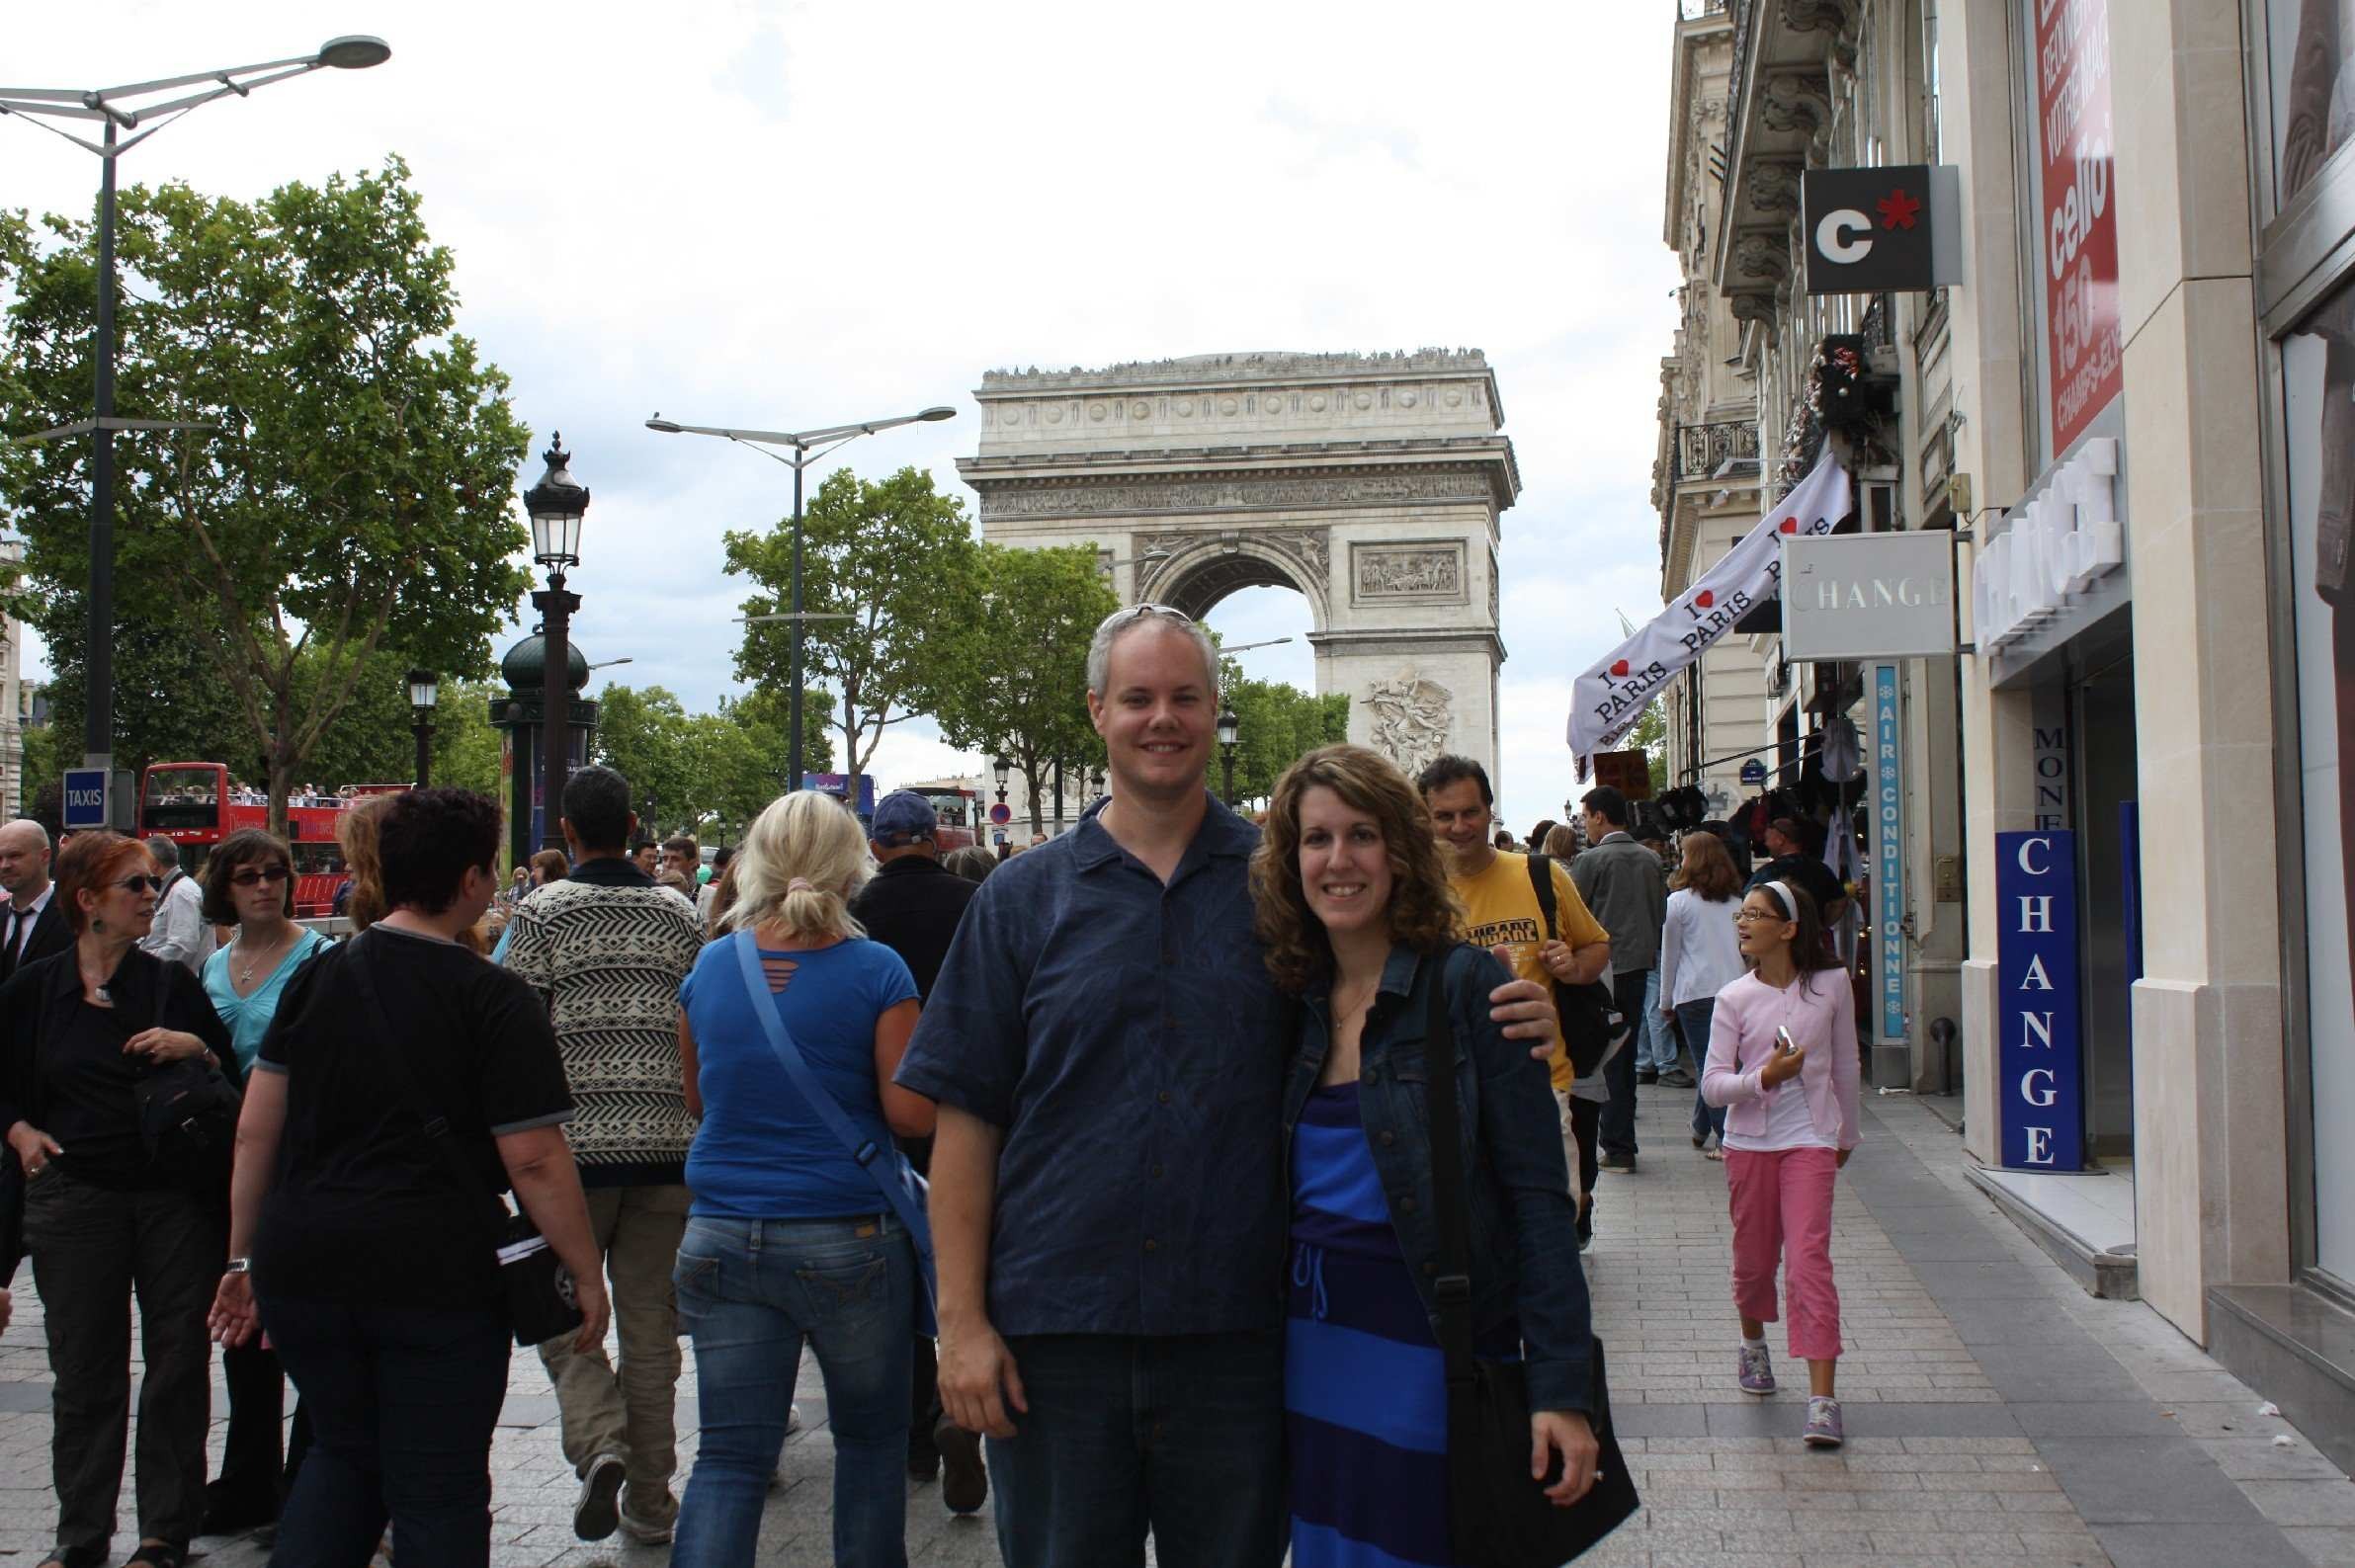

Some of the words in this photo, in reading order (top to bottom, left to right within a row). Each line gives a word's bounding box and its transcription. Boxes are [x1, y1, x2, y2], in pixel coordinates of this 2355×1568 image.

[2047, 63, 2079, 166] VOTRE
[2055, 254, 2093, 379] 150
[2057, 320, 2121, 432] CHAMPS-ÉLY
[1680, 590, 1751, 654] PARIS
[1684, 602, 1702, 620] I
[1594, 661, 1667, 724] PARIS
[1598, 671, 1617, 690] I
[1880, 705, 1895, 759] AIR
[68, 788, 102, 807] TAXIS
[1882, 786, 1900, 994] CONDITIONNE
[2016, 837, 2058, 1164] CHANGE
